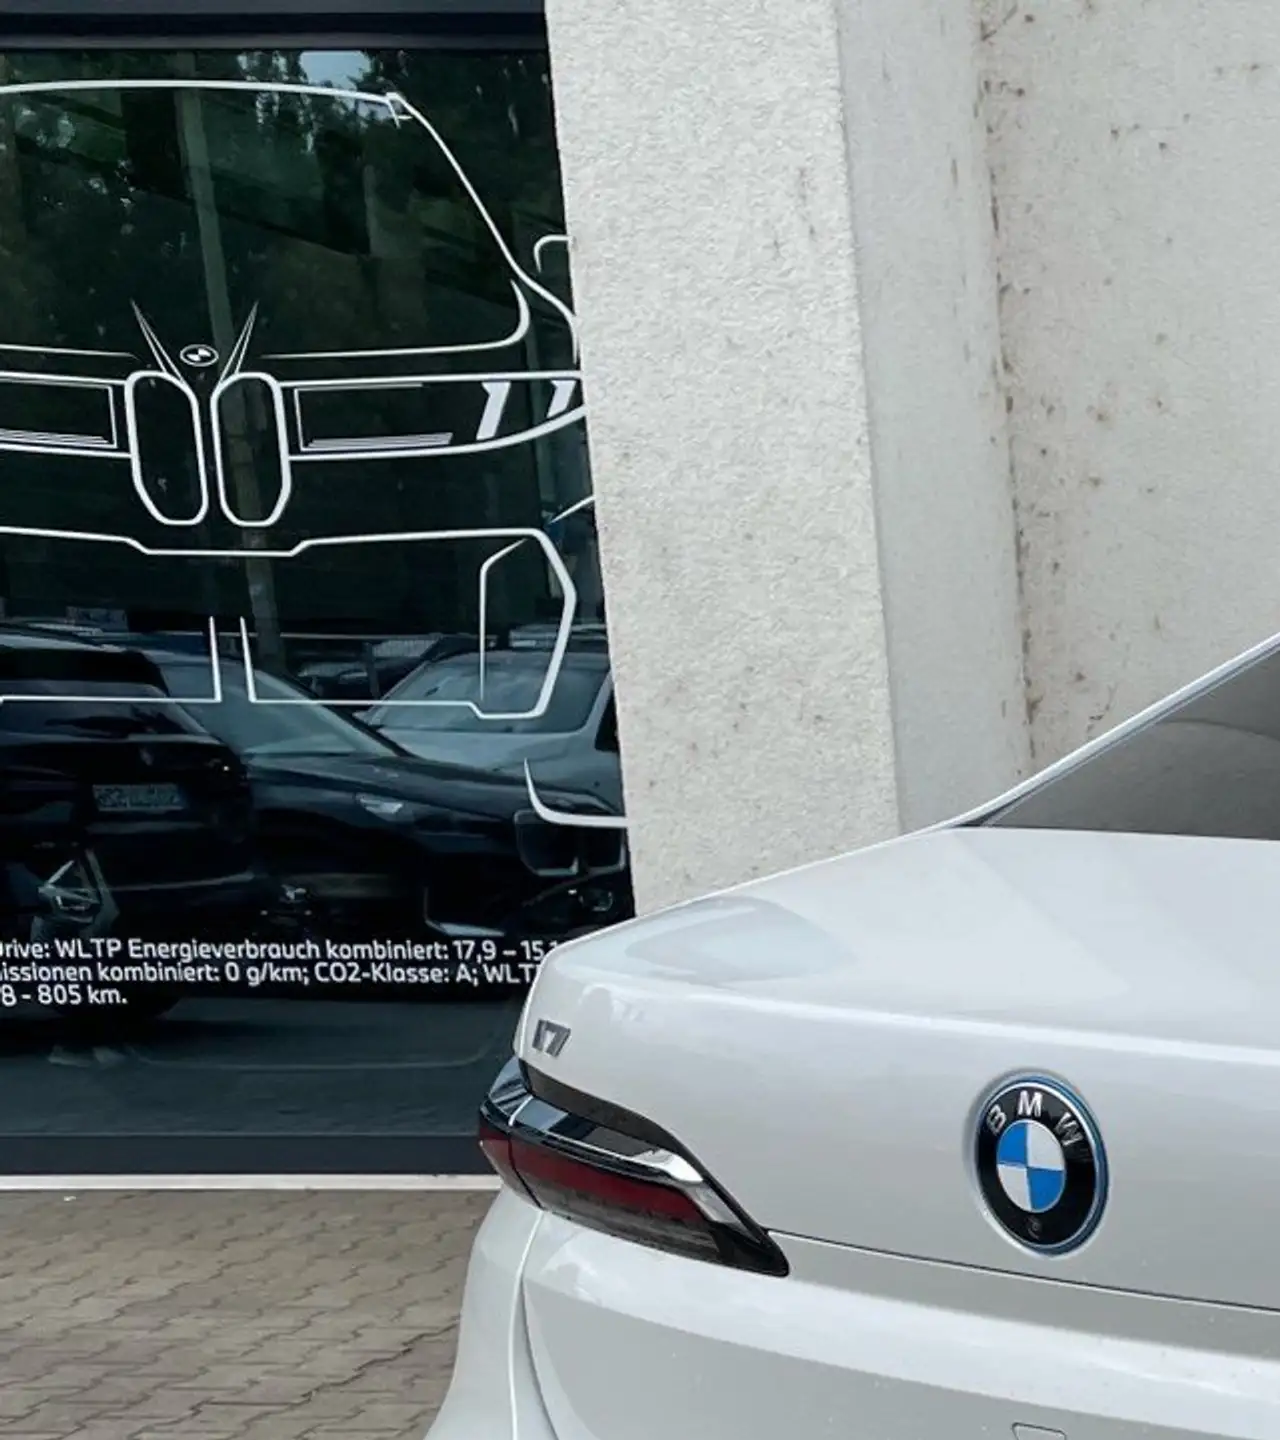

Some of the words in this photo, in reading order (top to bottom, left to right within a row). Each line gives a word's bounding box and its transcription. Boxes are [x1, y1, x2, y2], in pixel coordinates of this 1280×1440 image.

[0, 938, 50, 959] rive:
[54, 938, 122, 959] WLTP
[128, 938, 320, 963] Energieverbrauch
[325, 939, 449, 960] kombiniert:
[452, 940, 496, 964] 17,9
[0, 961, 92, 981] issionen
[97, 962, 220, 982] kombiniert:
[246, 962, 309, 987] g/km;
[314, 962, 449, 983] CO2-Klasse:
[456, 963, 478, 987] A;
[482, 963, 541, 984] WLT
[0, 984, 17, 1007] 8
[37, 984, 82, 1005] 805
[87, 985, 128, 1004] km.
[986, 1090, 1084, 1146] BMW
